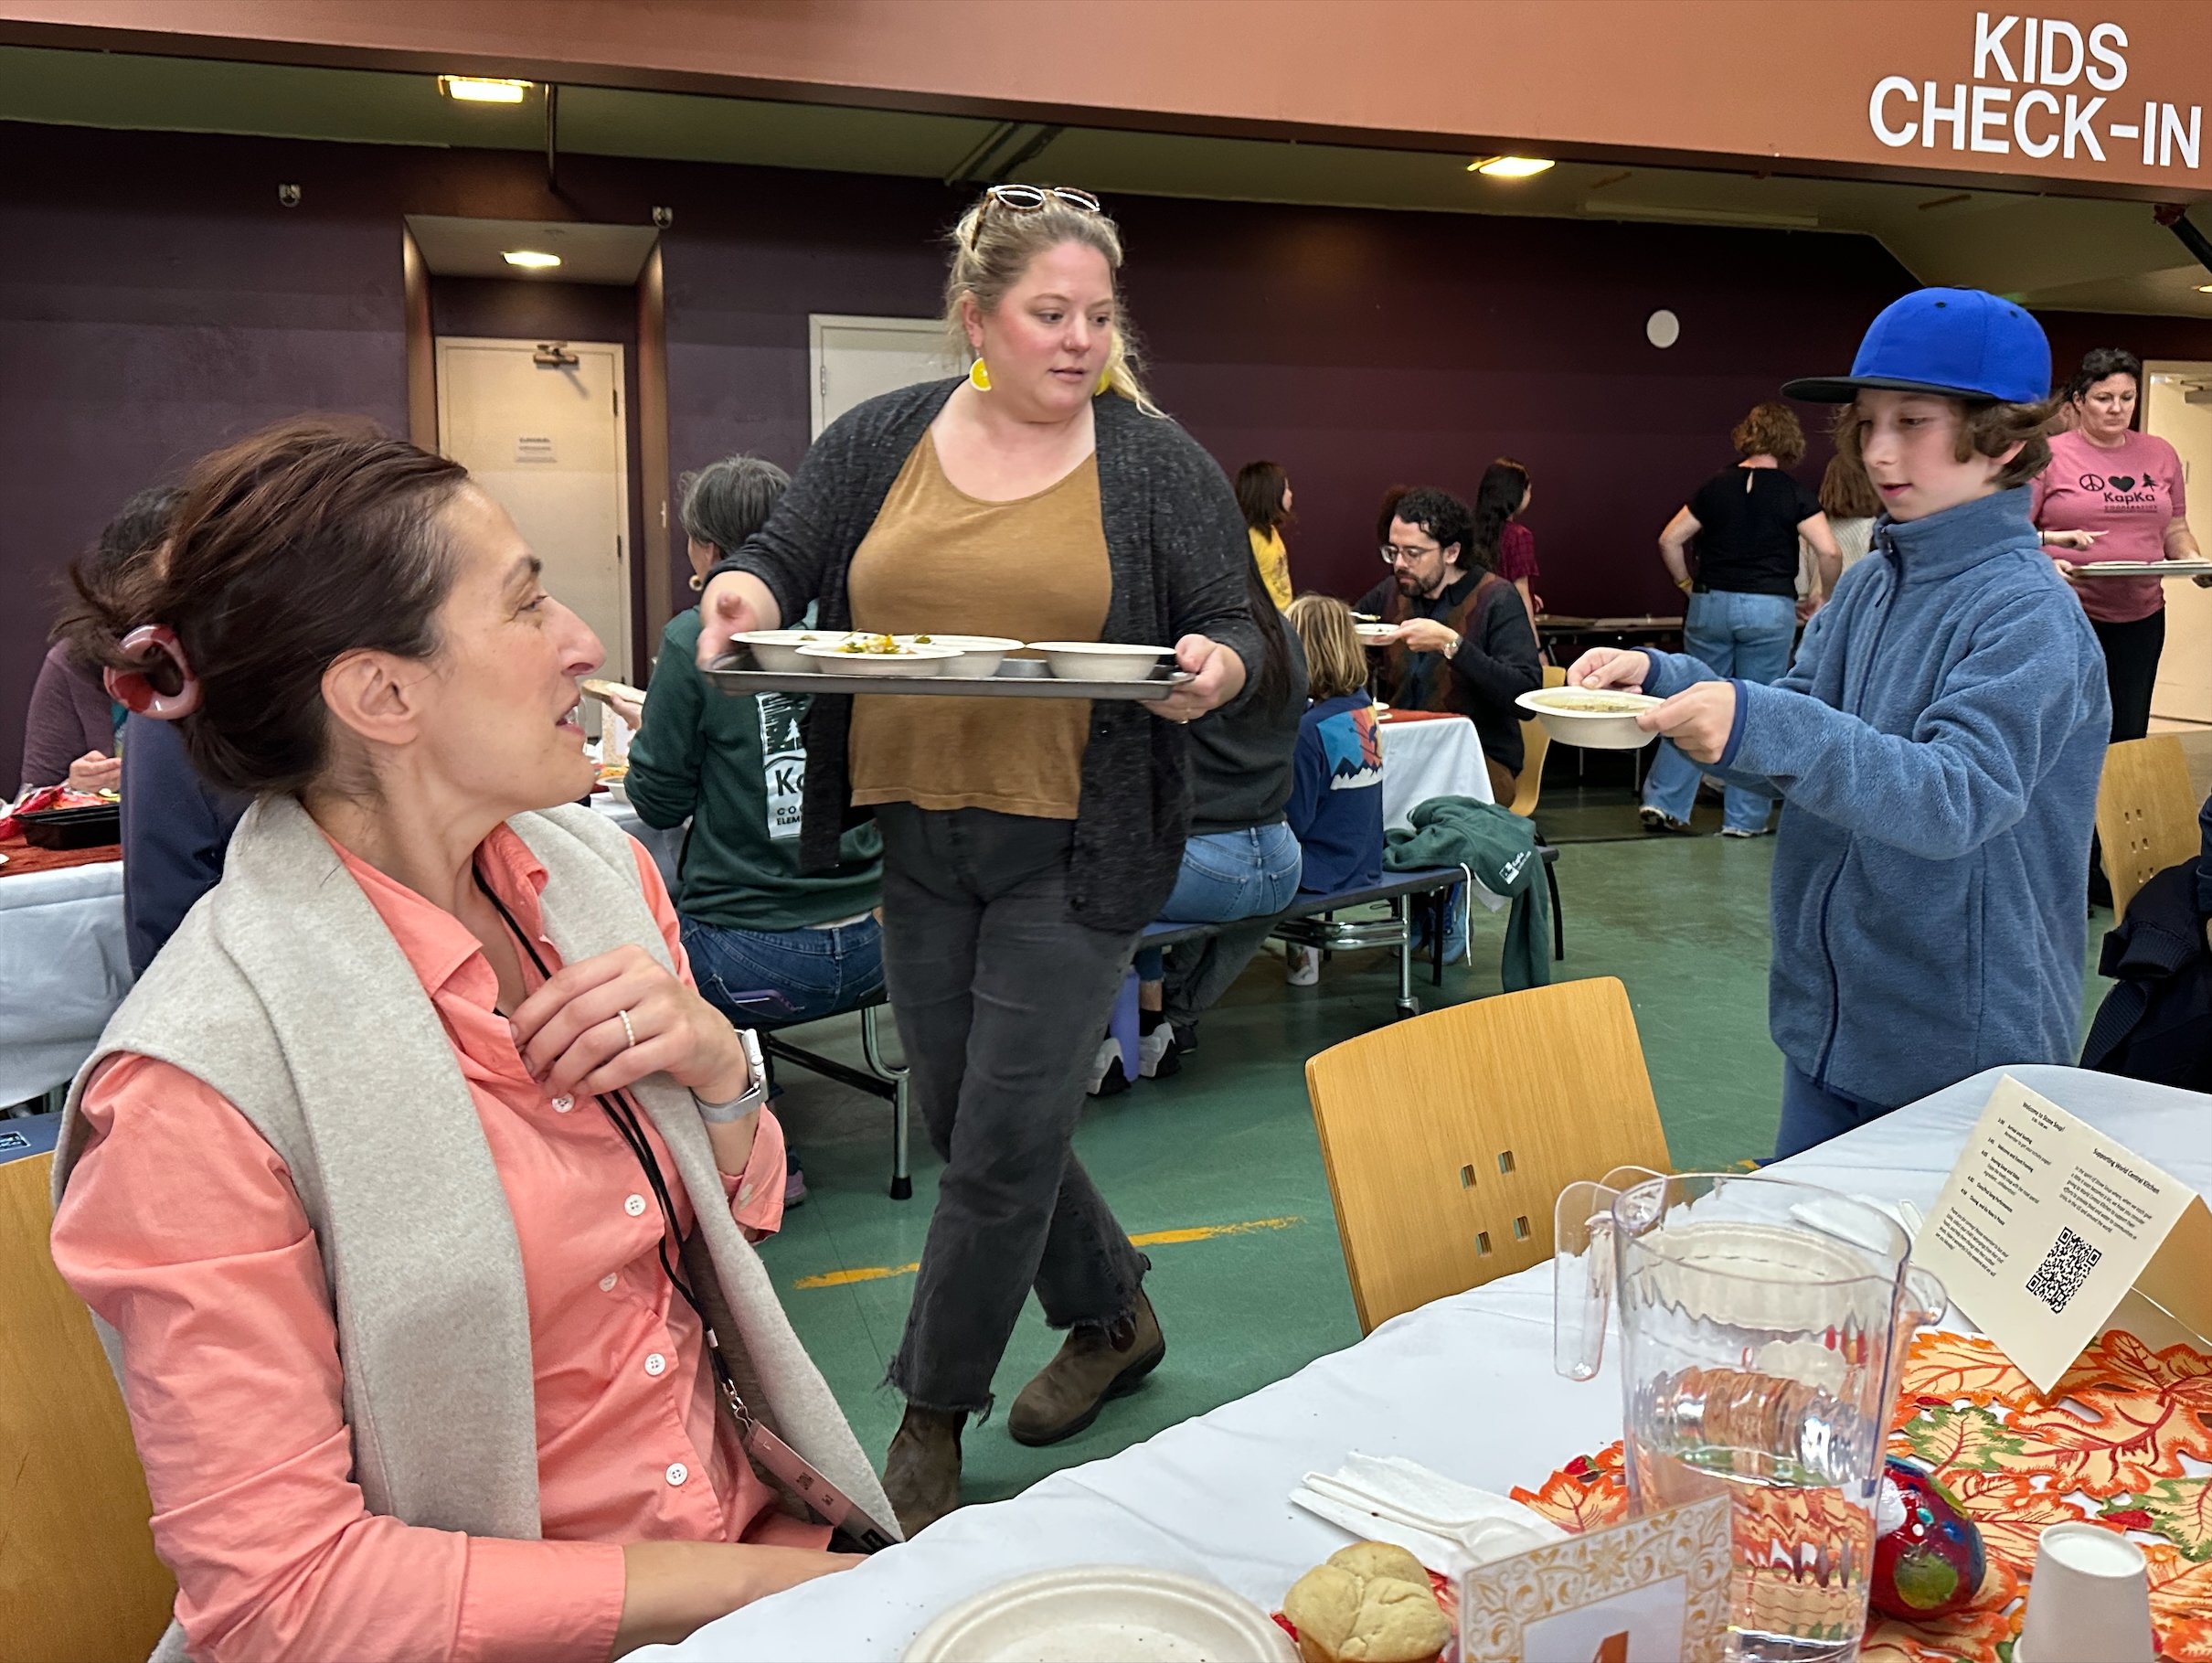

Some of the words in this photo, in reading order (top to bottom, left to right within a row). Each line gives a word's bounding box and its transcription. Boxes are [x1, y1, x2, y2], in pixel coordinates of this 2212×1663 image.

[1973, 12, 2129, 91] KIDS
[1869, 75, 2202, 169] CHECK-IN
[2104, 492, 2155, 505] KapKa
[2023, 1102, 2039, 1115] Welcome
[2043, 1114, 2054, 1125] Stone
[2053, 1122, 2065, 1132] Soup!
[1997, 1144, 2010, 1156] Welcome
[2093, 1148, 2116, 1167] Supporting
[2115, 1163, 2129, 1174] World
[2127, 1170, 2144, 1184] Central
[2143, 1180, 2160, 1194] Kitchen
[2095, 1179, 2104, 1188] Stone
[2103, 1185, 2112, 1193] Soup
[2080, 1189, 2090, 1198] World
[2089, 1194, 2100, 1204] Central
[2100, 1202, 2111, 1212] Kitchen
[2114, 1213, 2128, 1222] support
